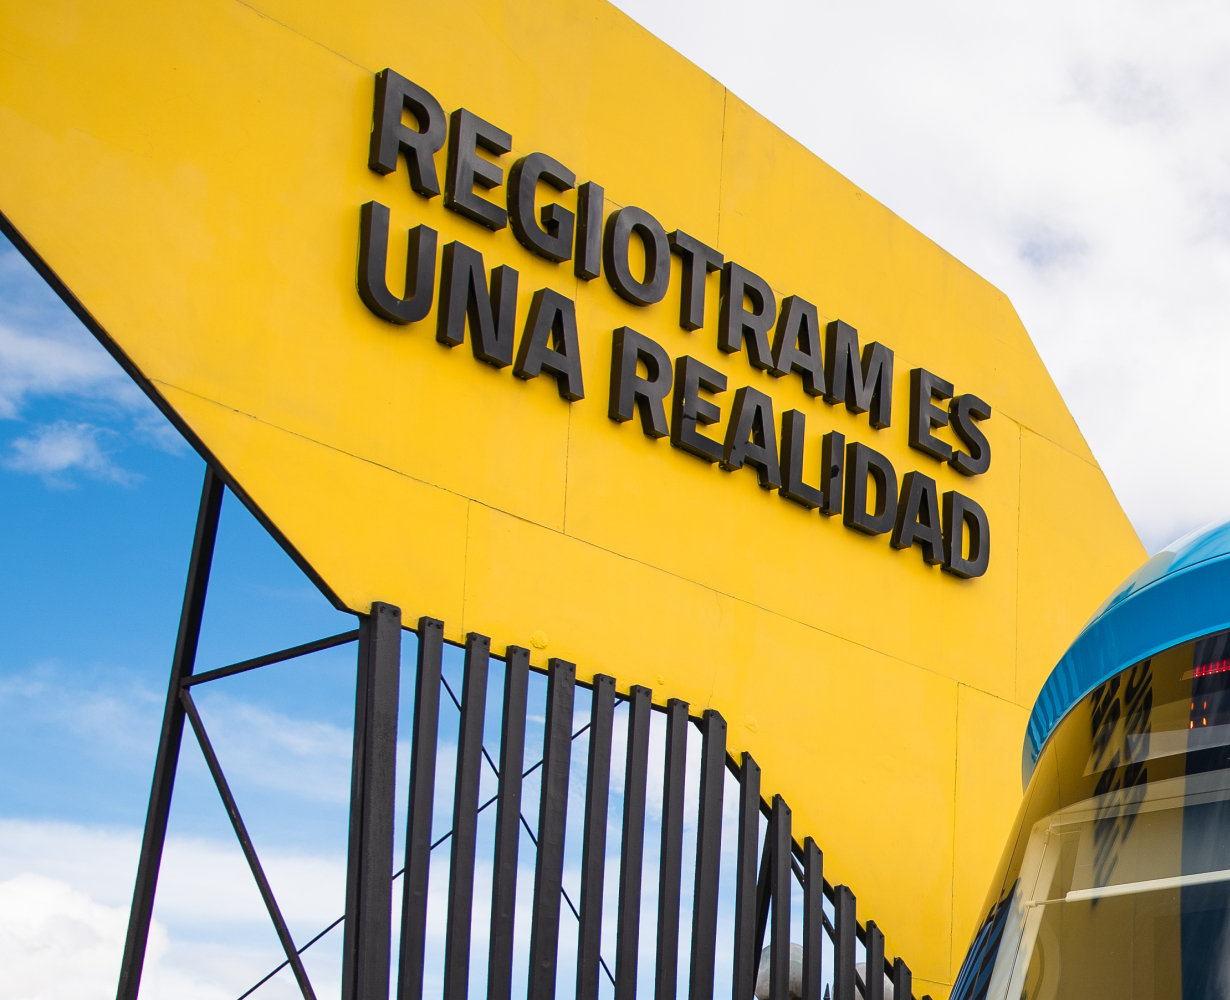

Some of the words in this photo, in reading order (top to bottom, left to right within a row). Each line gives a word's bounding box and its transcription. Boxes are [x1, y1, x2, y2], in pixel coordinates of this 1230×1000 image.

[356, 200, 585, 403] UNA
[607, 325, 991, 580] REALIDAD
[367, 67, 895, 430] REGIOTRAM
[908, 367, 992, 477] ES
